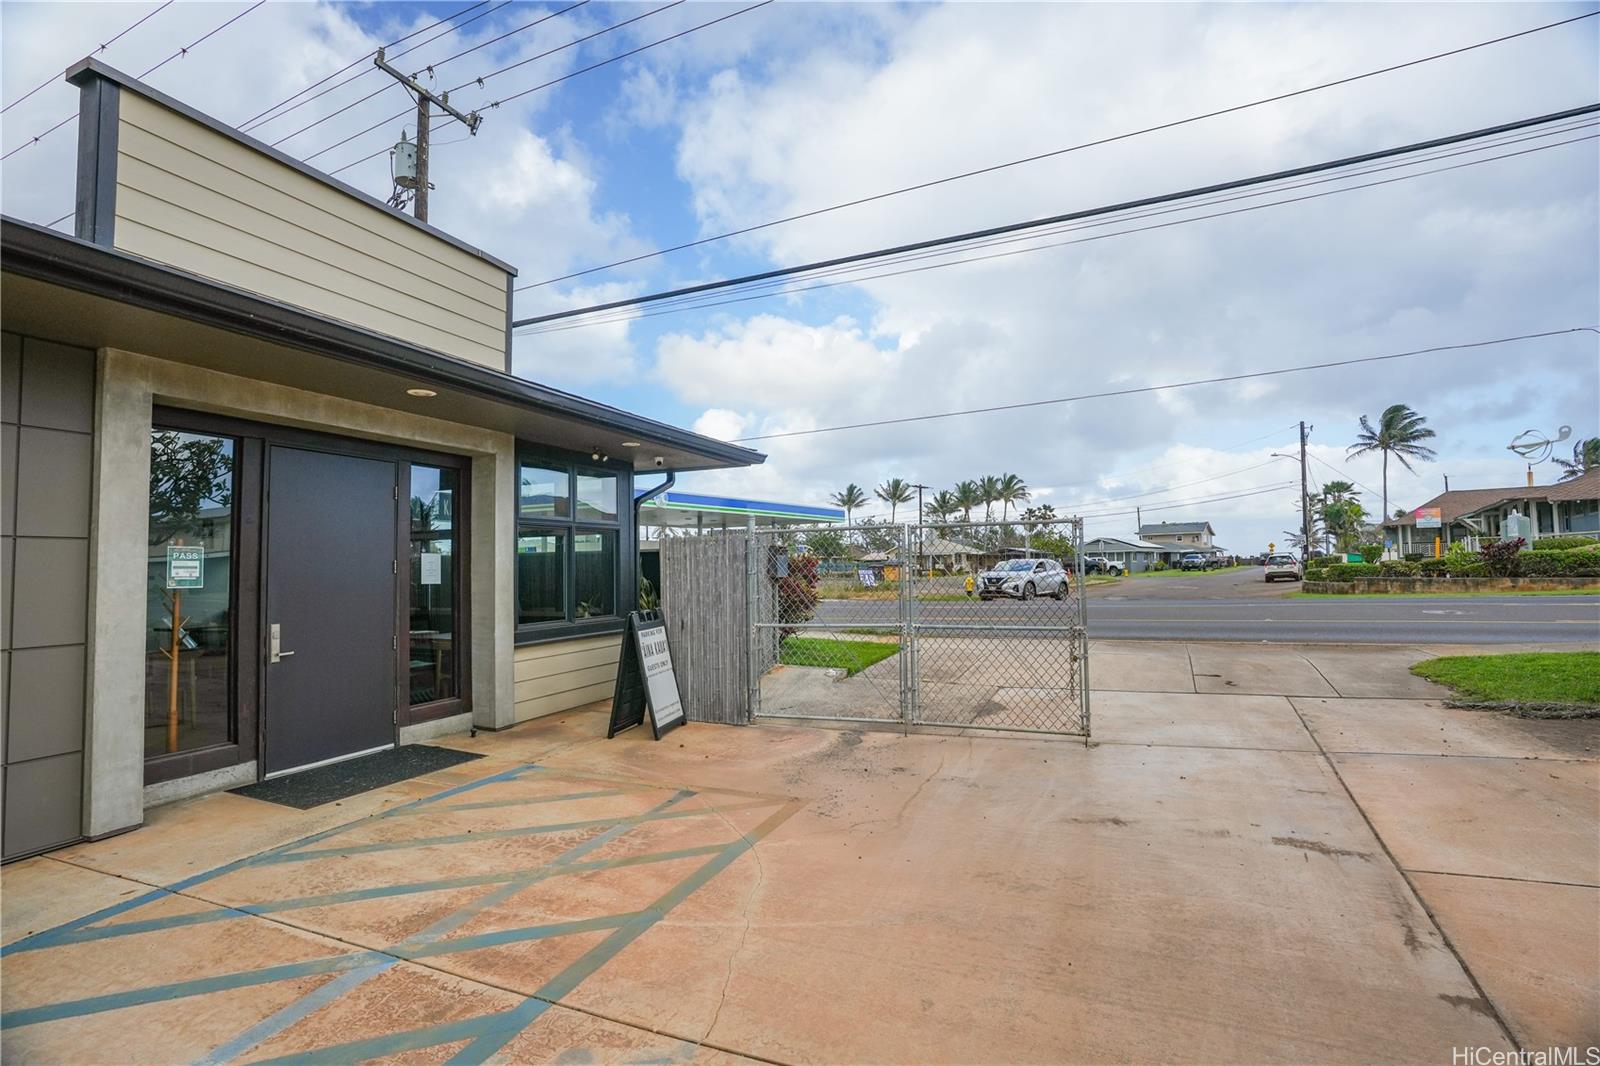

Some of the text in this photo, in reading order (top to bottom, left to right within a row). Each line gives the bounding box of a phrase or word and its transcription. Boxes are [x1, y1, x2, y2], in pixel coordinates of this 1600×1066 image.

[173, 552, 199, 560] PASS
[640, 630, 656, 638] PARKING
[647, 660, 669, 672] GUESTS ONLY
